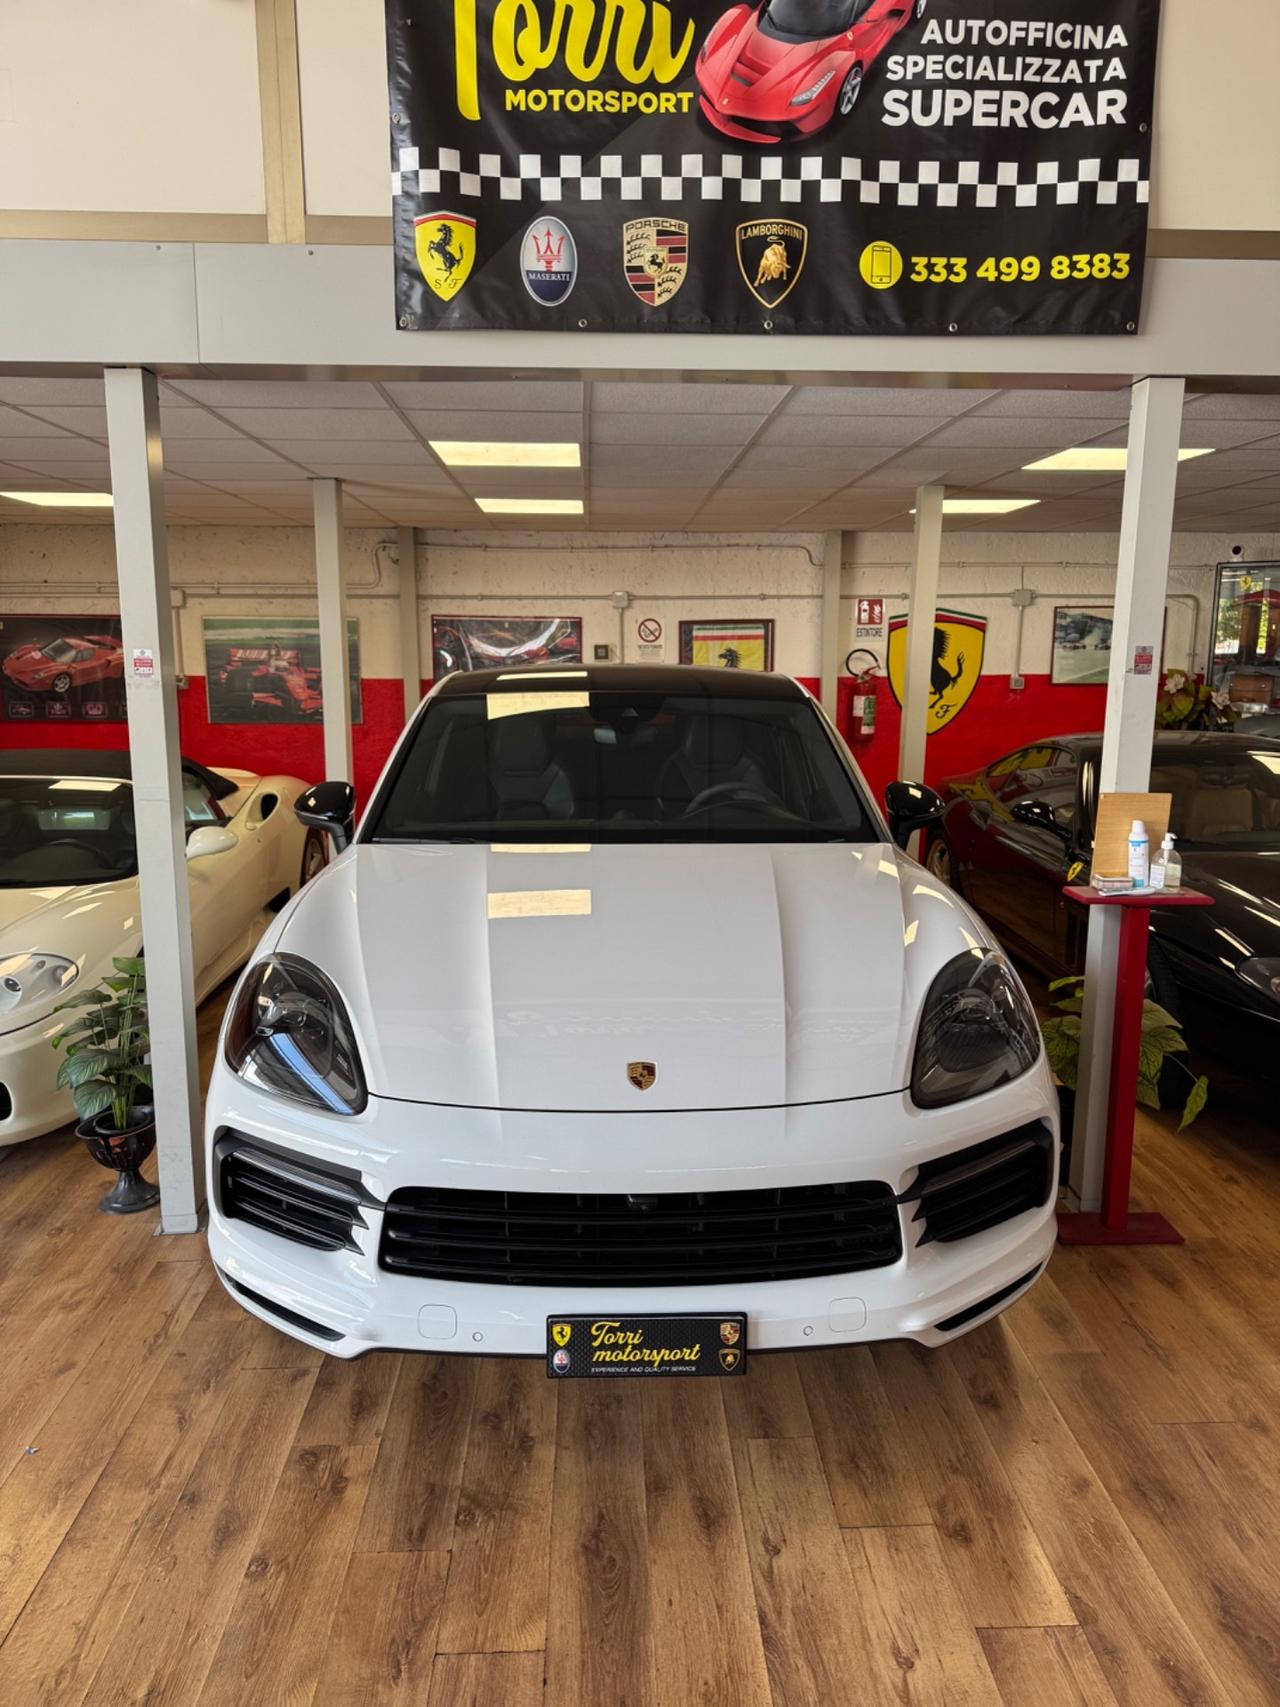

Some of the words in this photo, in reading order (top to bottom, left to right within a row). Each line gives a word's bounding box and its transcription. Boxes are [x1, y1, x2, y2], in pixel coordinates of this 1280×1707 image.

[920, 18, 1128, 50] AUTOFFICINA
[886, 54, 1127, 84] SPECIALIZZATA
[505, 88, 694, 114] MOTORSPORT
[881, 88, 1128, 129] SUPERCAR
[625, 220, 686, 233] PORSCHE
[741, 223, 803, 240] LAMBORGHINI
[528, 272, 570, 282] MASERATI
[910, 256, 968, 283] 333
[976, 256, 1041, 282] 499
[1050, 253, 1131, 280] 8383
[590, 1321, 643, 1347] Torri
[592, 1343, 701, 1367] motorsport
